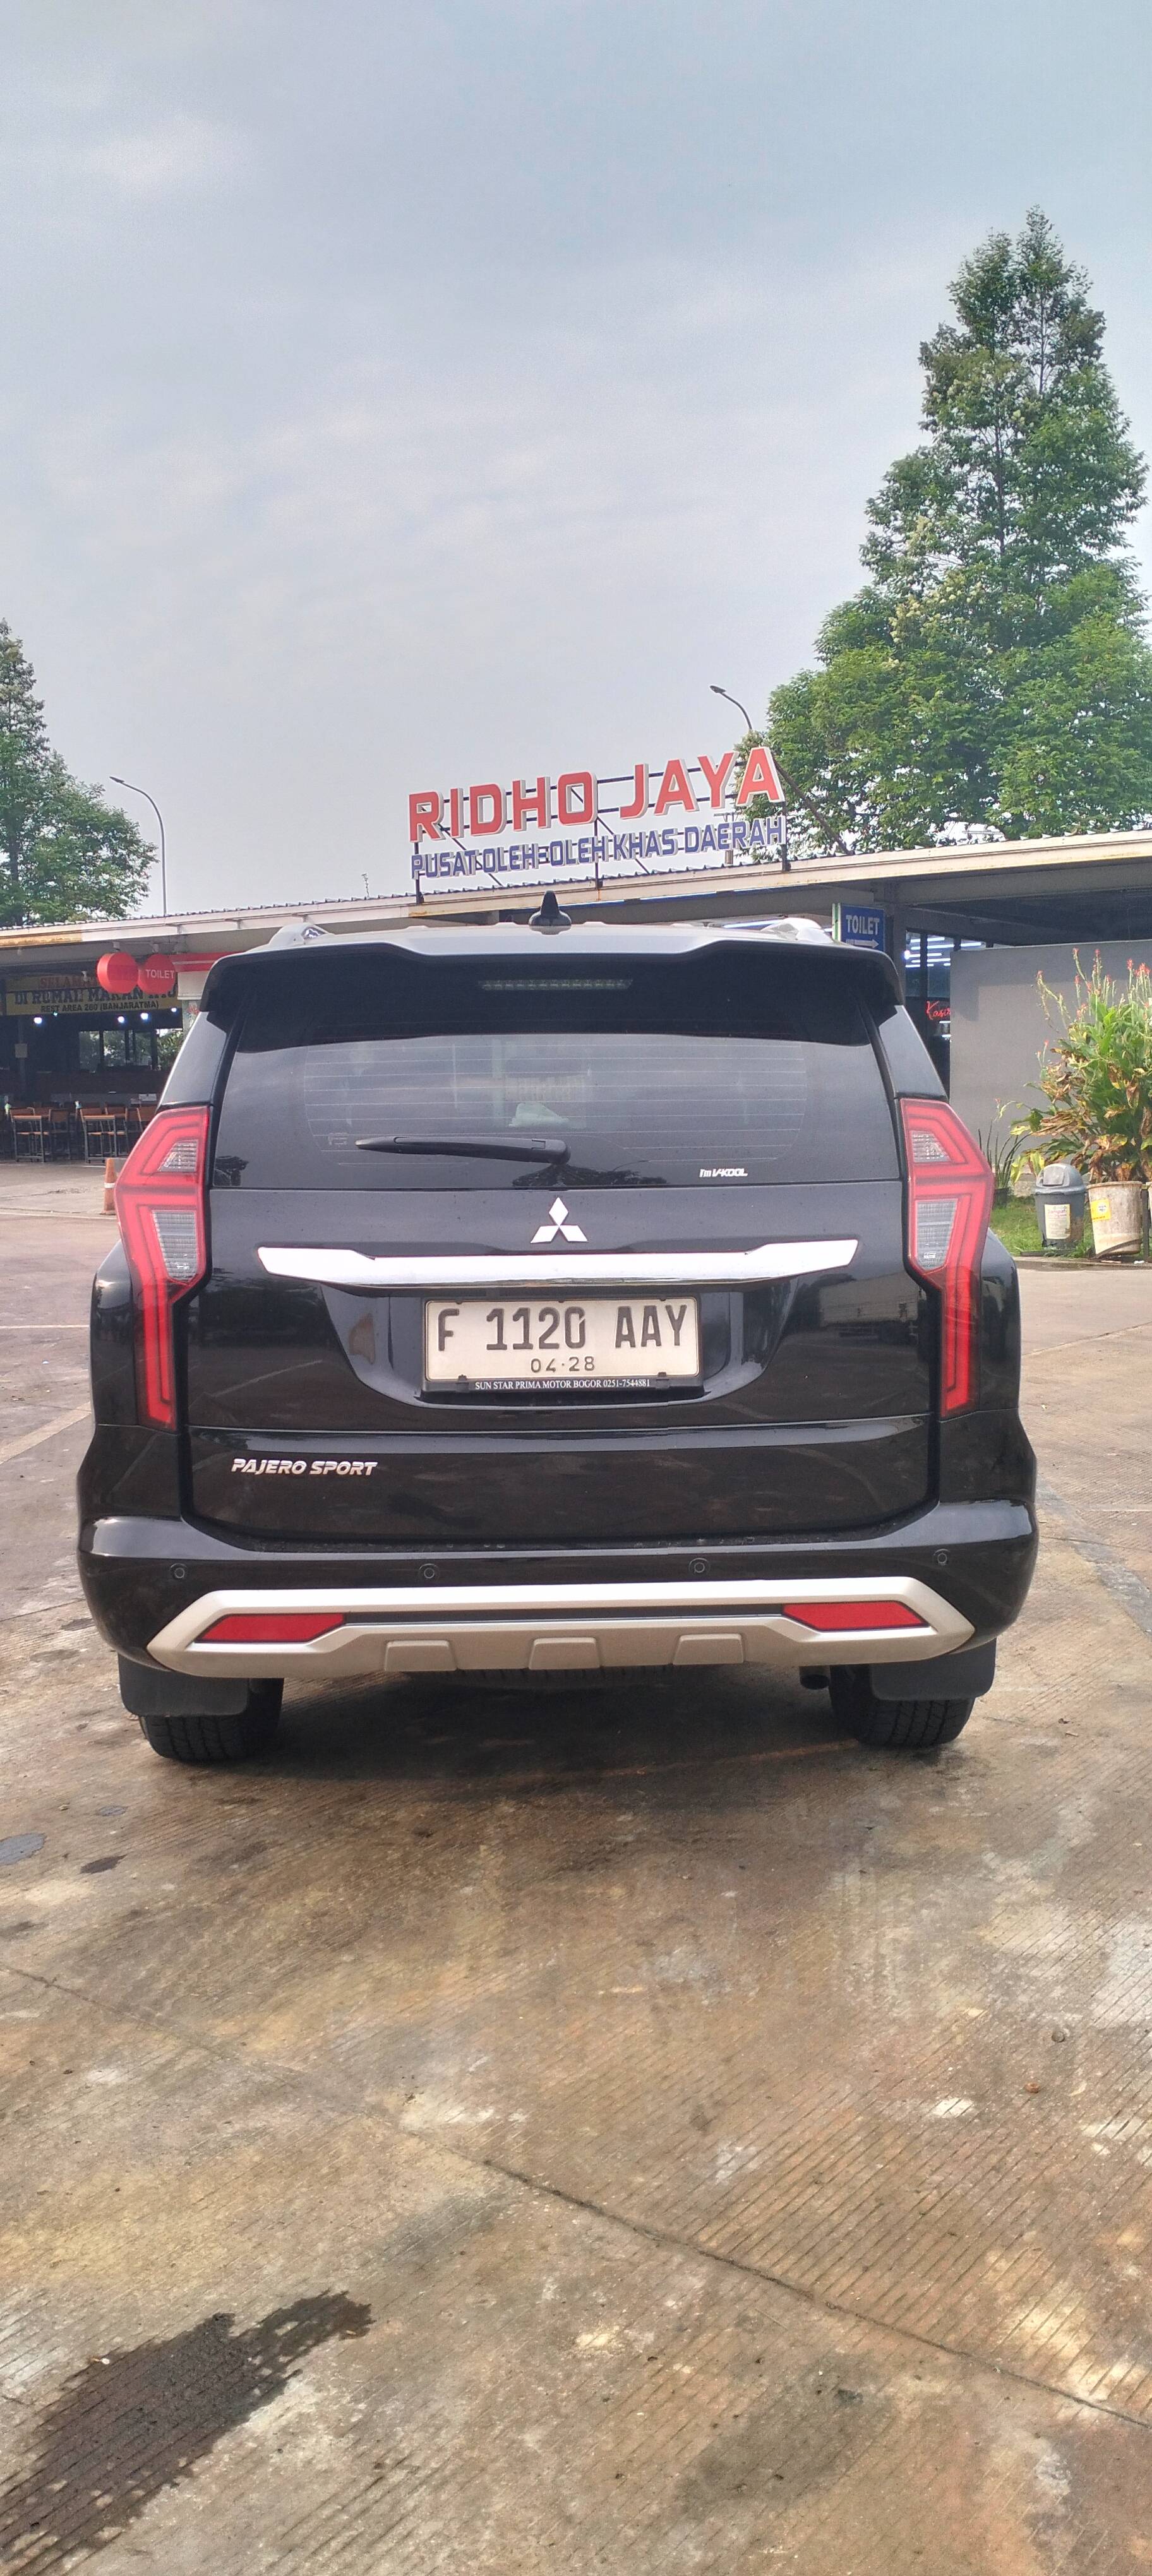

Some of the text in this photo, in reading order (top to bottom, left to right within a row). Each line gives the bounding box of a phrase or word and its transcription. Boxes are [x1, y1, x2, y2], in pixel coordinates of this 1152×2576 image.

[409, 746, 785, 842] RIDHO JAYA
[411, 849, 478, 880] PUSAT
[613, 827, 678, 861] KHAS
[684, 815, 786, 854] DAERAH
[846, 915, 880, 935] TOILET
[145, 969, 175, 979] TOILET
[41, 1005, 61, 1013] REST
[62, 1004, 82, 1012] AREA
[438, 1304, 688, 1351] F 1120 AAY
[493, 1381, 513, 1390] STAR
[515, 1381, 541, 1389] PRIMA
[543, 1380, 571, 1389] MOTOR
[573, 1380, 601, 1388] BOGOR
[603, 1379, 650, 1388] 0251-7544881
[231, 1458, 378, 1476] PAJERO SPORT
